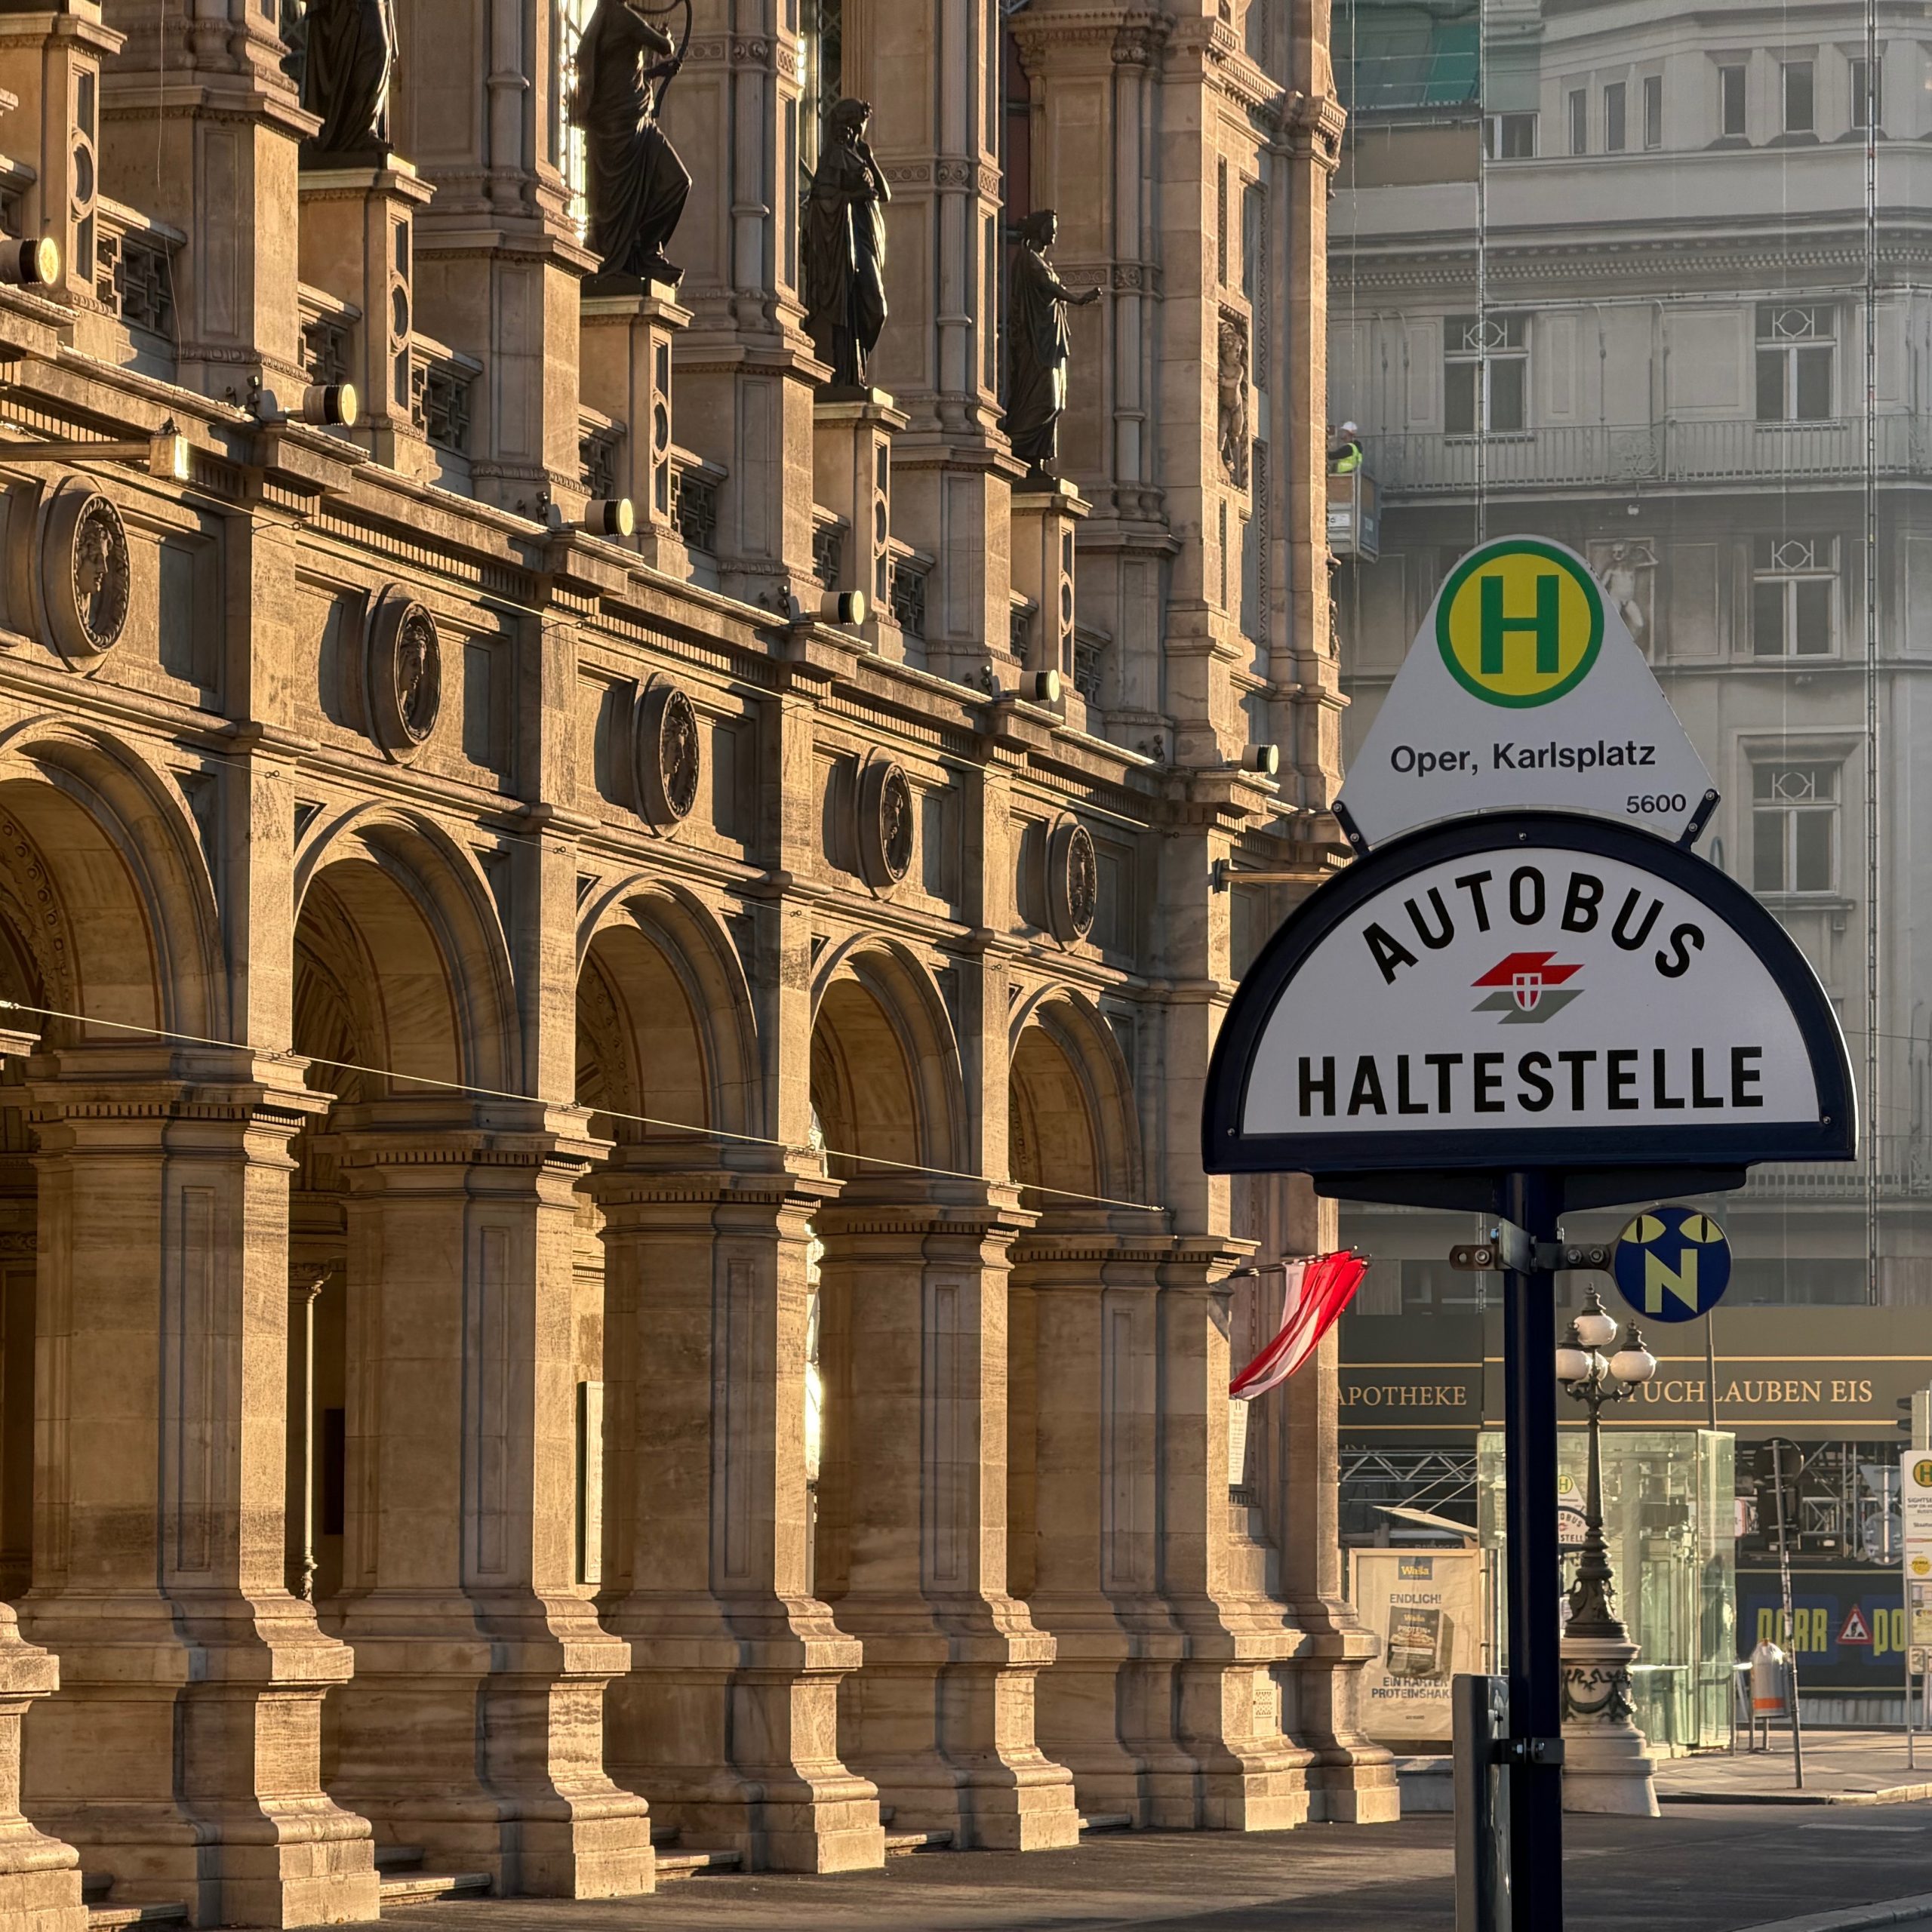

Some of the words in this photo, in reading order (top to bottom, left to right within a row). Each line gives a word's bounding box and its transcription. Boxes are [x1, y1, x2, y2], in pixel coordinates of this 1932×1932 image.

[1481, 574, 1559, 674] H
[1390, 745, 1479, 778] Oper,
[1493, 740, 1657, 774] Karlsplatz
[1626, 793, 1687, 815] 5600
[1362, 866, 1705, 986] AUTOBUS
[1298, 1046, 1763, 1117] HALTESTELLE
[1644, 1247, 1698, 1314] N
[1830, 1380, 1873, 1403] EIS
[1389, 1593, 1442, 1604] ENDLICH!
[1371, 1687, 1453, 1699] PROTEINSHAK
[1383, 1676, 1401, 1687] EIN
